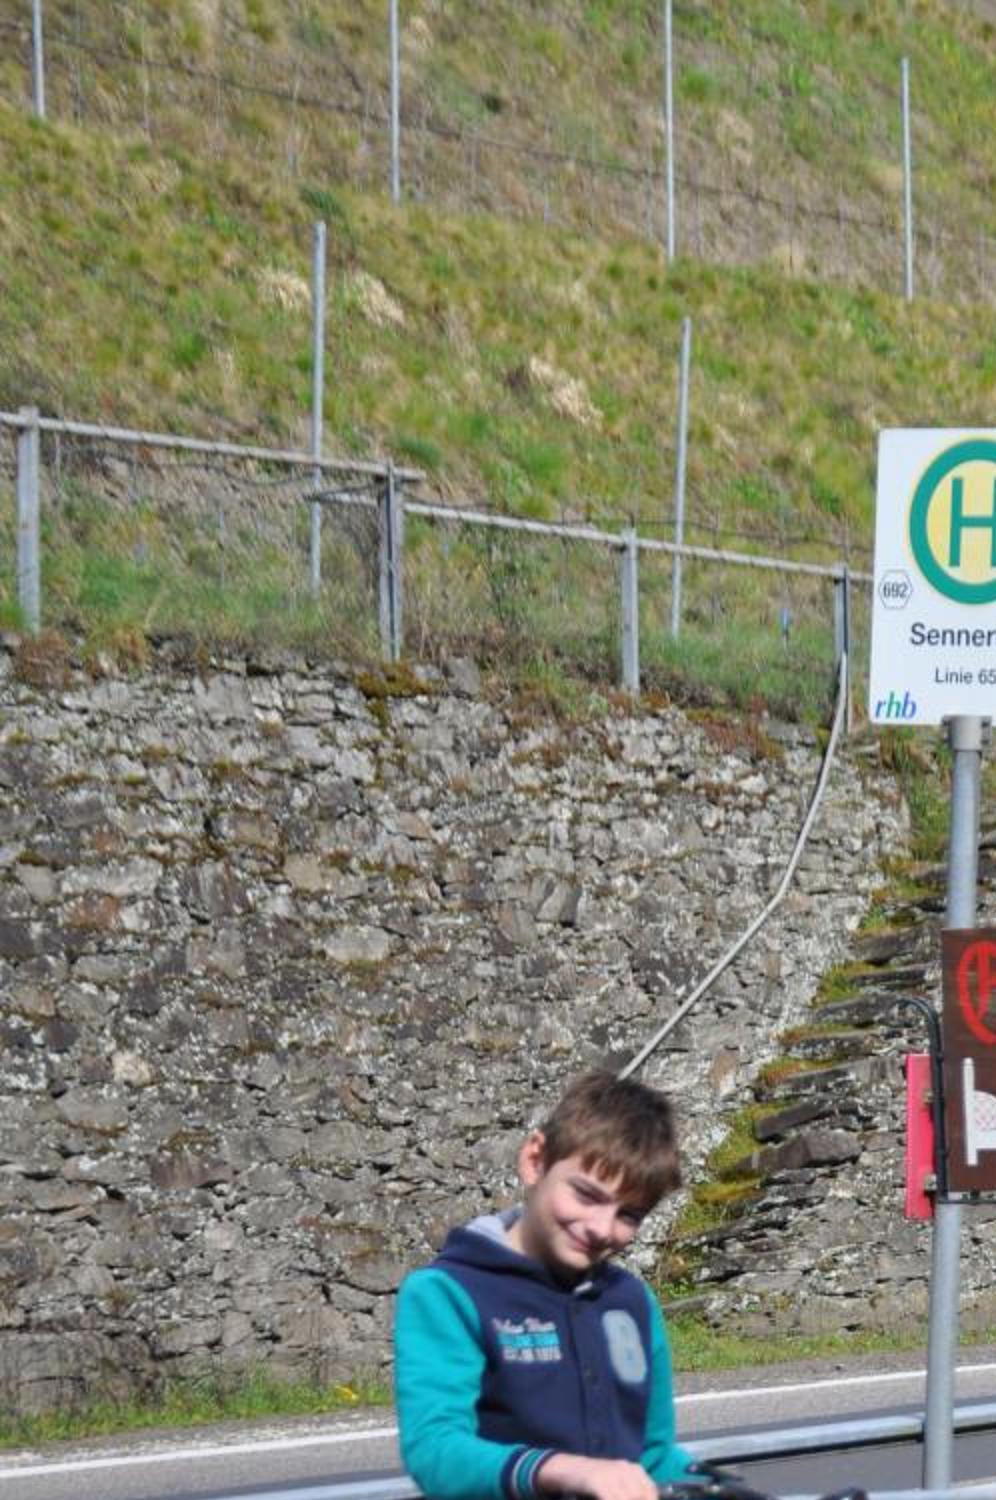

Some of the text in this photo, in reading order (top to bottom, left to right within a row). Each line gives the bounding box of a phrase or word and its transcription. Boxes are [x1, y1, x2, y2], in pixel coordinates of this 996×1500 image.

[882, 581, 909, 599] 692
[934, 666, 973, 685] Linie
[875, 691, 917, 719] rhb
